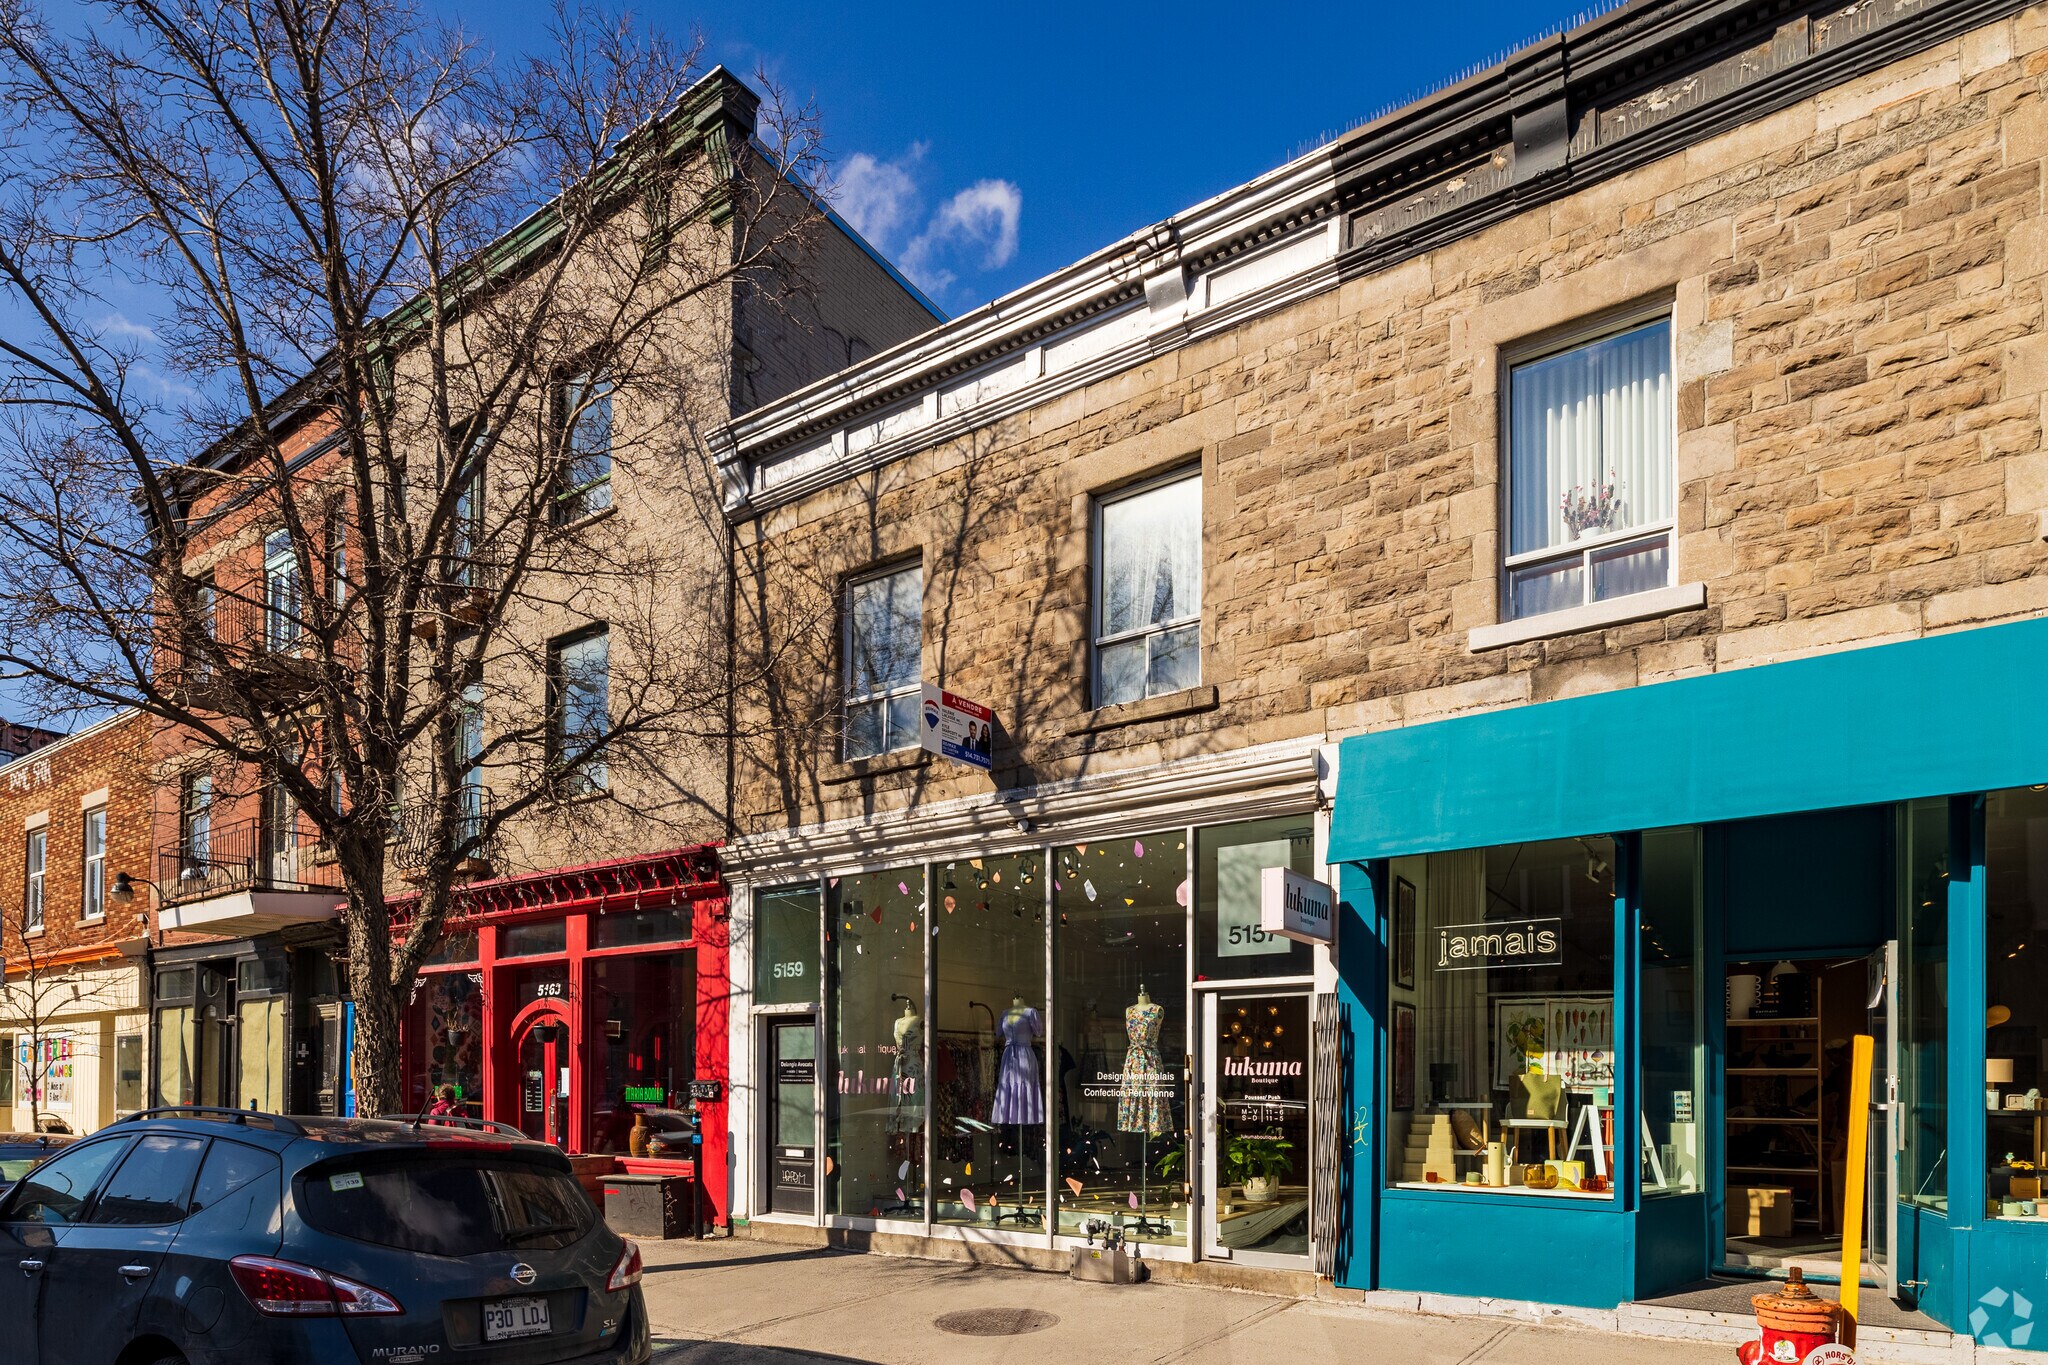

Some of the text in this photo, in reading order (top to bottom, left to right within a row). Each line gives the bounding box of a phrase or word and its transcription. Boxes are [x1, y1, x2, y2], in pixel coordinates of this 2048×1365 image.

[958, 700, 983, 714] VENDRE
[1286, 883, 1329, 920] lukuma
[1438, 925, 1557, 966] jamais
[773, 961, 804, 978] 5159
[49, 1064, 73, 1078] MANOS
[1224, 1056, 1302, 1076] lukuma
[1097, 1071, 1175, 1082] Design Montréalais
[1084, 1088, 1175, 1098] Confection Péruvienne
[513, 1270, 537, 1278] NISSAN
[486, 1306, 549, 1331] P30 LDJ
[602, 1319, 617, 1329] SL
[372, 1344, 440, 1357] MURANO
[1824, 1350, 1847, 1361] HORS
